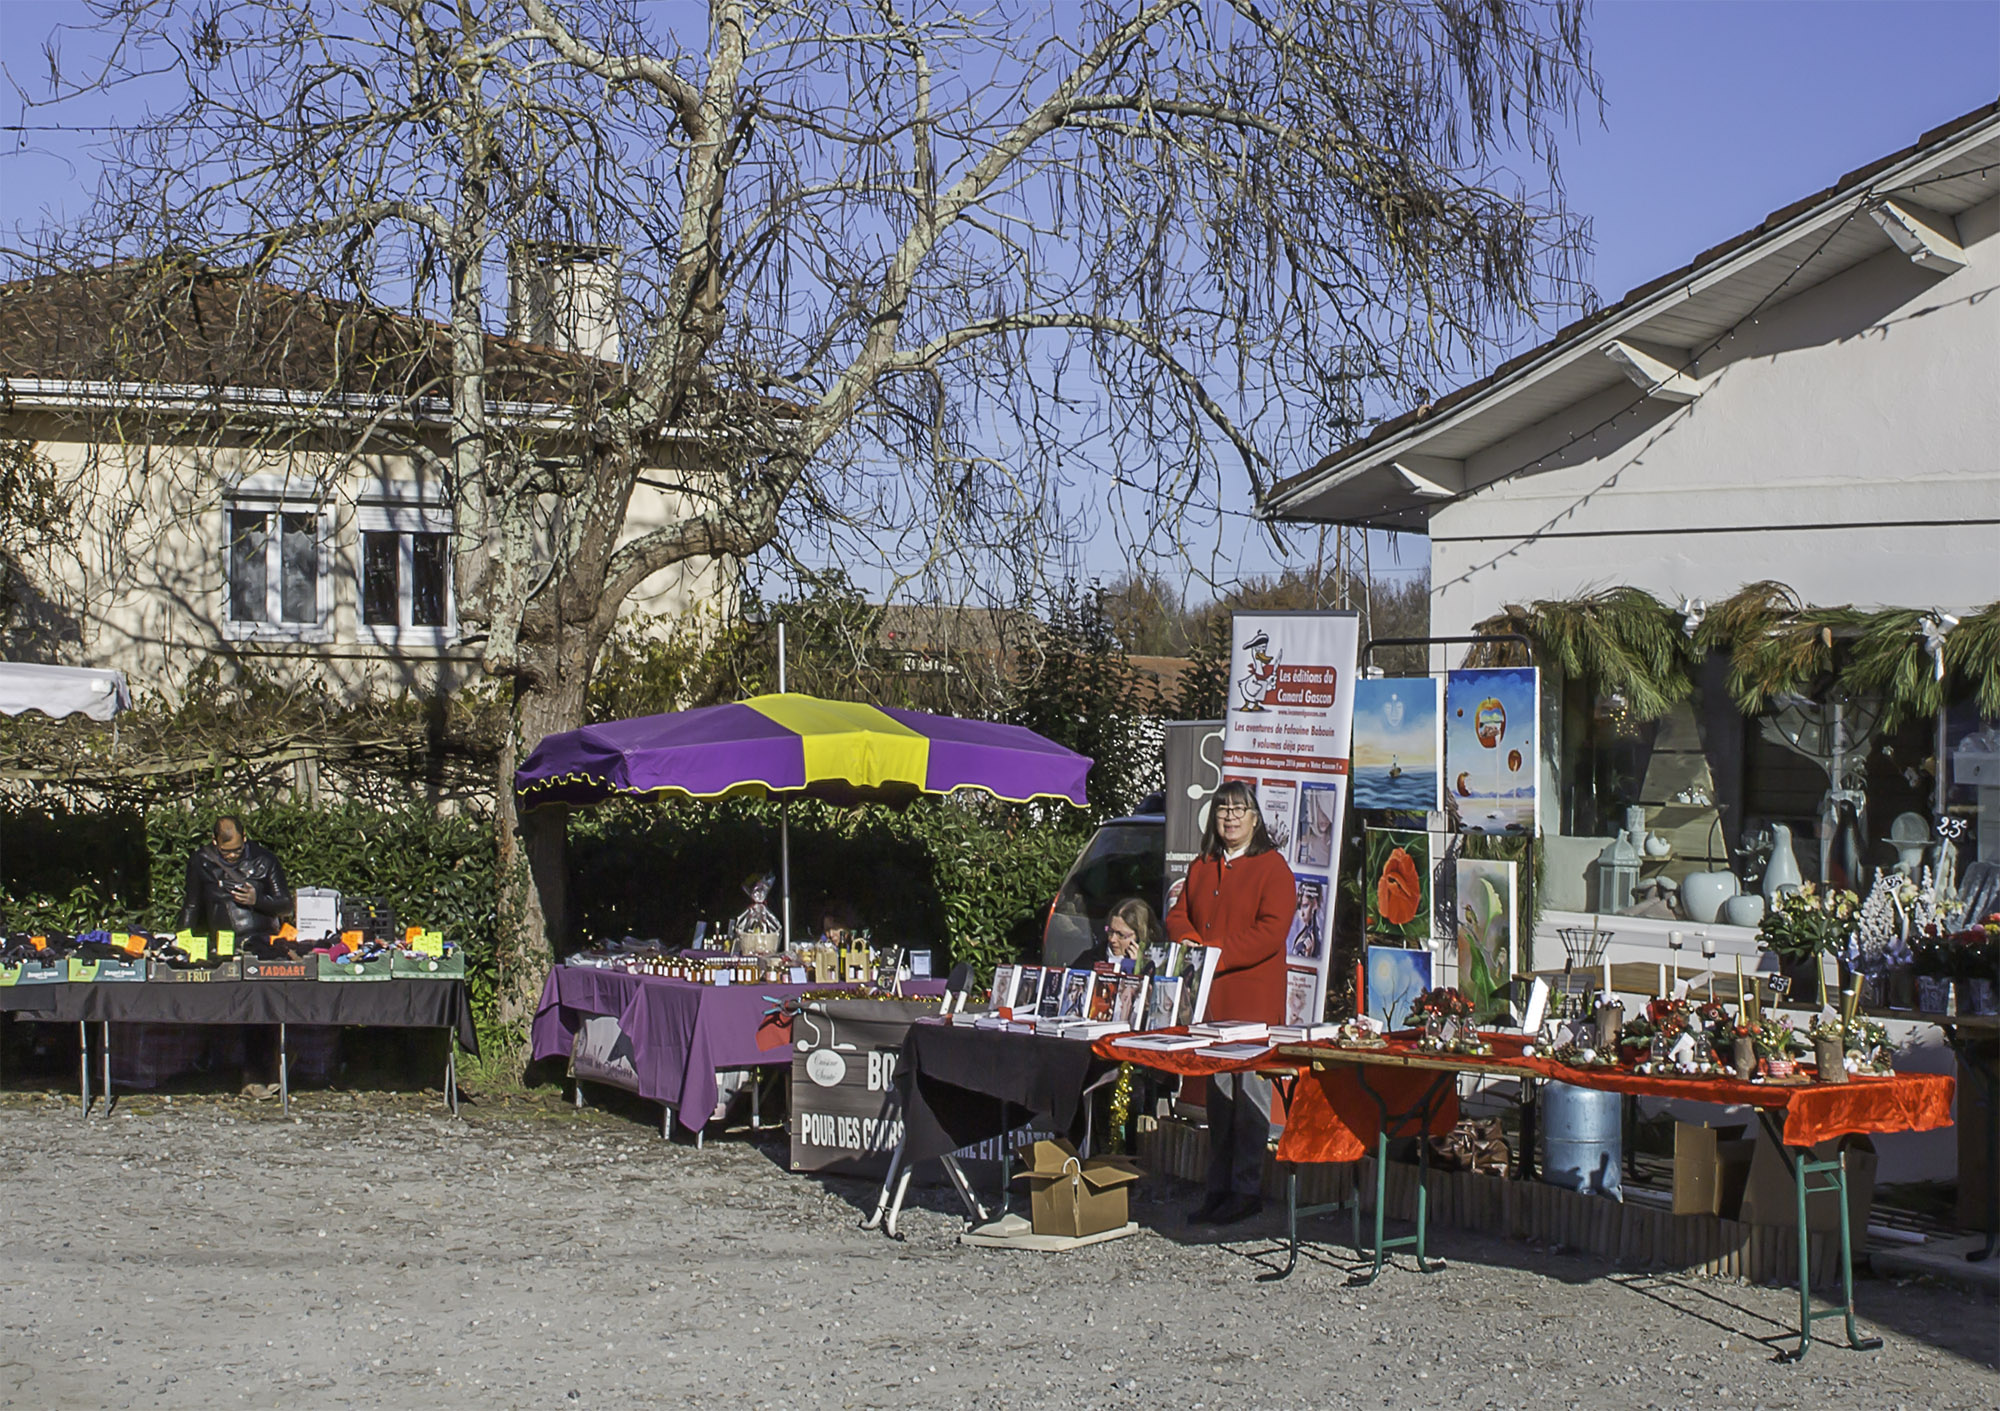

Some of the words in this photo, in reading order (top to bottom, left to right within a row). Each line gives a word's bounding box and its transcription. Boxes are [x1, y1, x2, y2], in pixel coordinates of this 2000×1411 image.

[1279, 669, 1291, 682] Les
[1292, 669, 1322, 684] éditions
[1323, 669, 1334, 684] du
[1277, 689, 1304, 703] Canard
[1305, 689, 1332, 704] Gascon
[1234, 721, 1244, 732] Les
[1257, 738, 1282, 750] volumes
[868, 1050, 899, 1092] BO
[801, 1113, 836, 1147] POUR
[837, 1116, 860, 1150] DES
